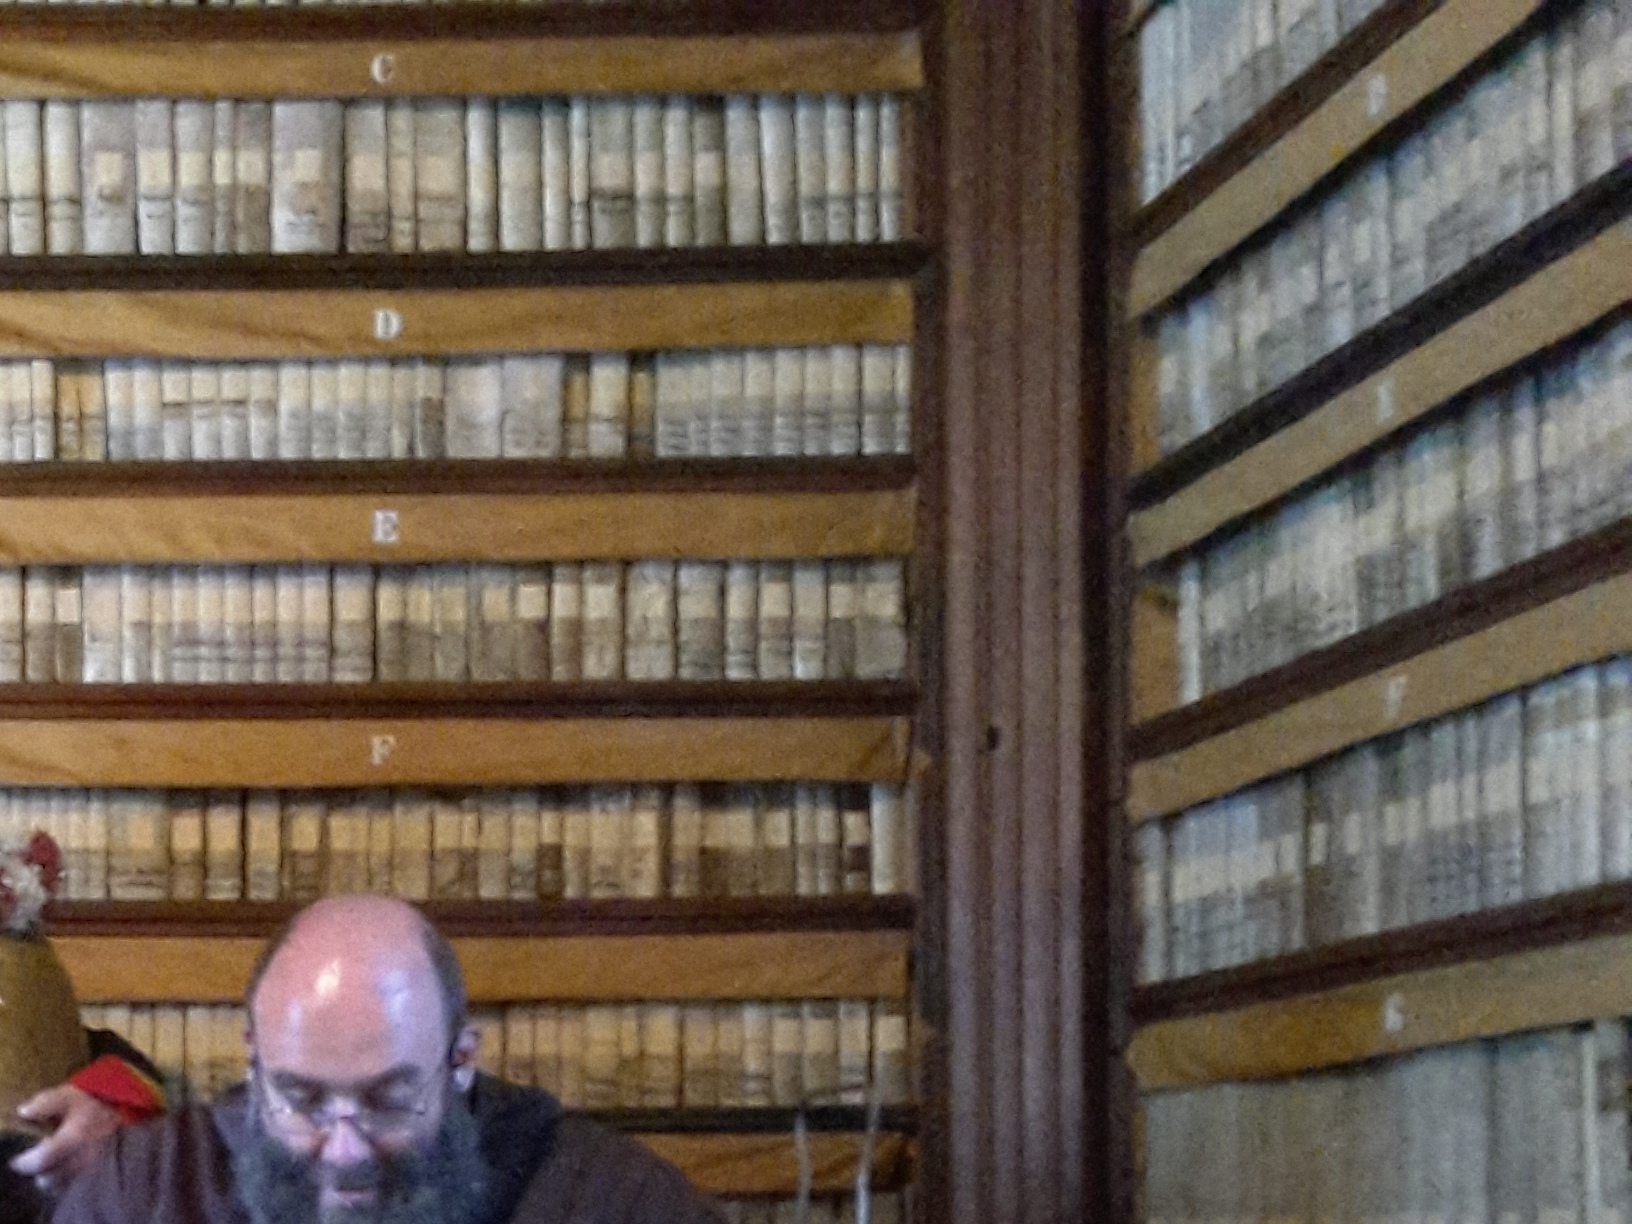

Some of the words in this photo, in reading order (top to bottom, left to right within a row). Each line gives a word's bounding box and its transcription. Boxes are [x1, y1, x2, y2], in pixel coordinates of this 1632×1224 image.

[370, 307, 403, 338] D
[371, 509, 402, 543] E
[369, 734, 397, 764] F
